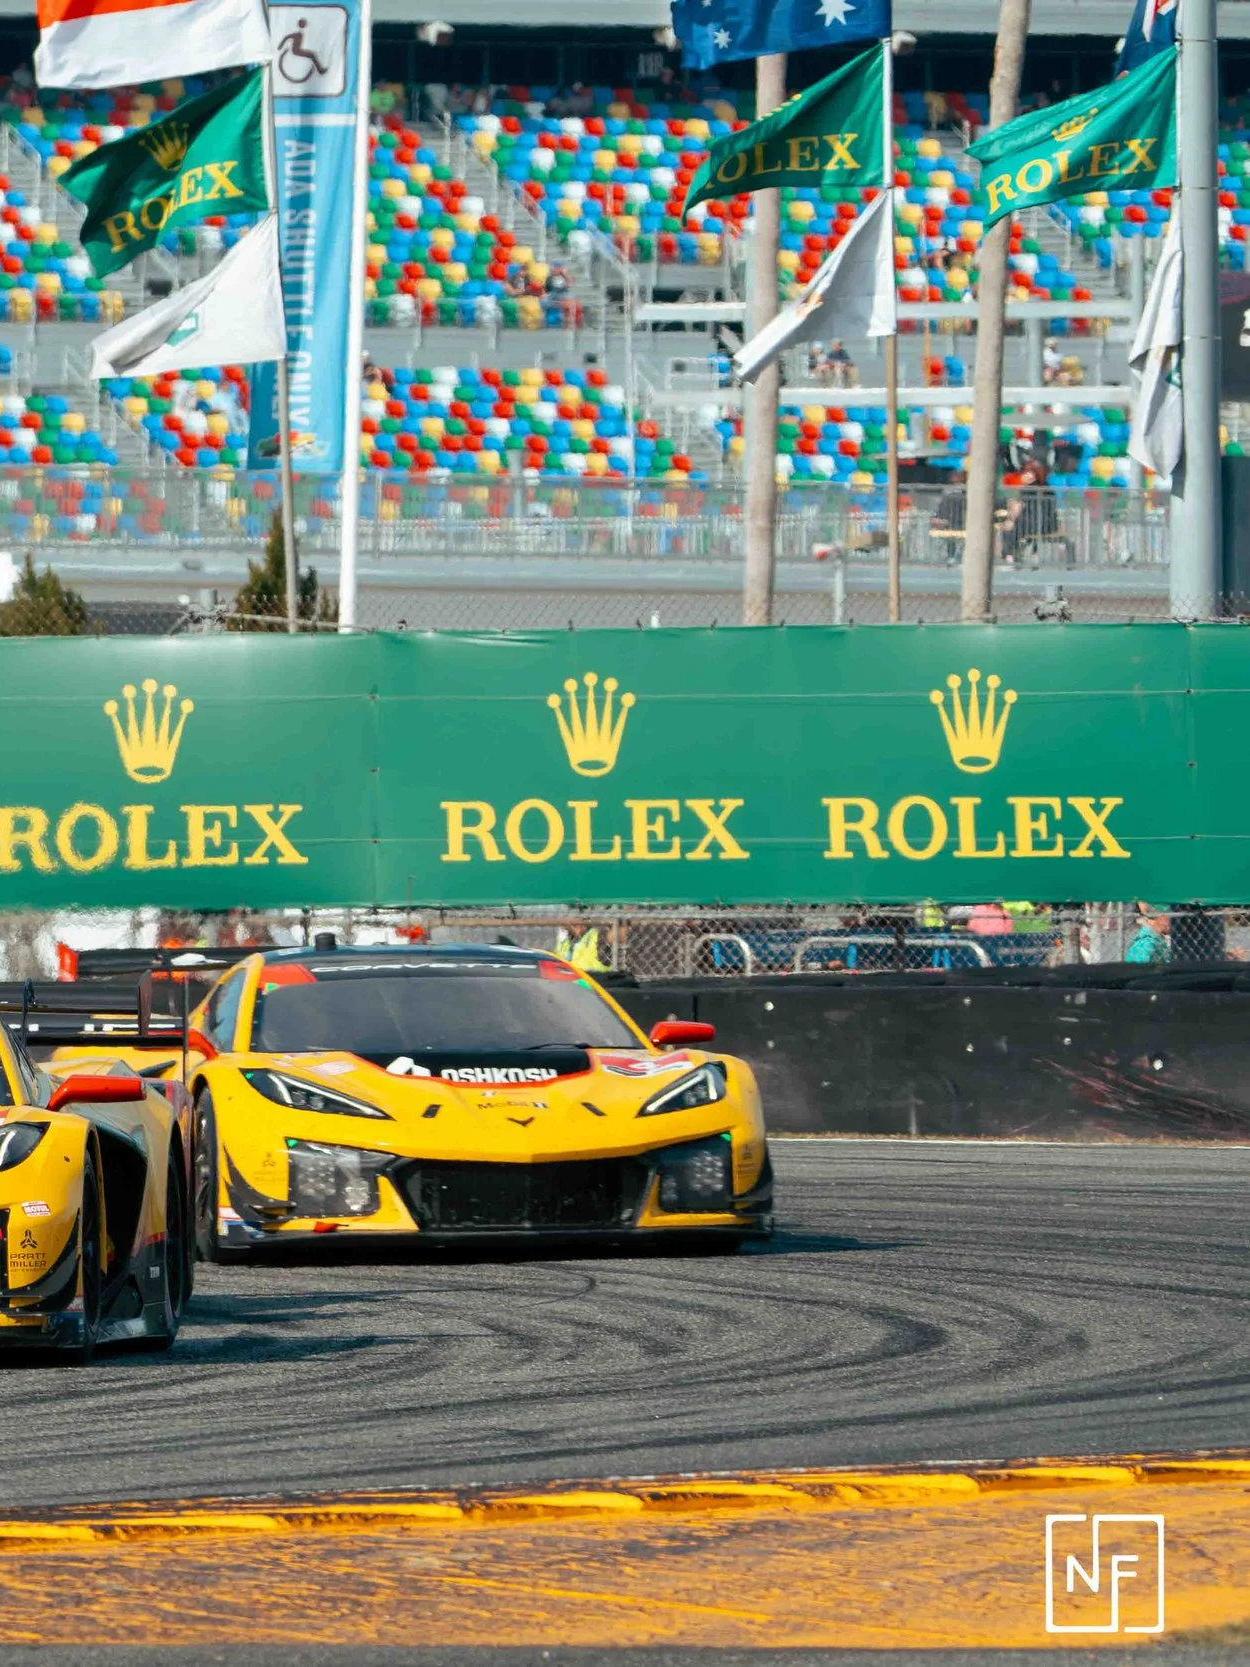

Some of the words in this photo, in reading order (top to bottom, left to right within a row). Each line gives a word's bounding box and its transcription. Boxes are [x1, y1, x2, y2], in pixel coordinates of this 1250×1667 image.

[283, 139, 317, 199] ADA
[705, 133, 860, 190] OLEX
[986, 137, 1158, 215] ROLEX
[283, 208, 317, 341] SHUTTLE
[287, 350, 313, 426] ONLY
[440, 799, 750, 862] ROLEX
[822, 795, 1131, 859] ROLEX
[10, 1252, 47, 1260] PRATT
[10, 1260, 48, 1268] MILLER
